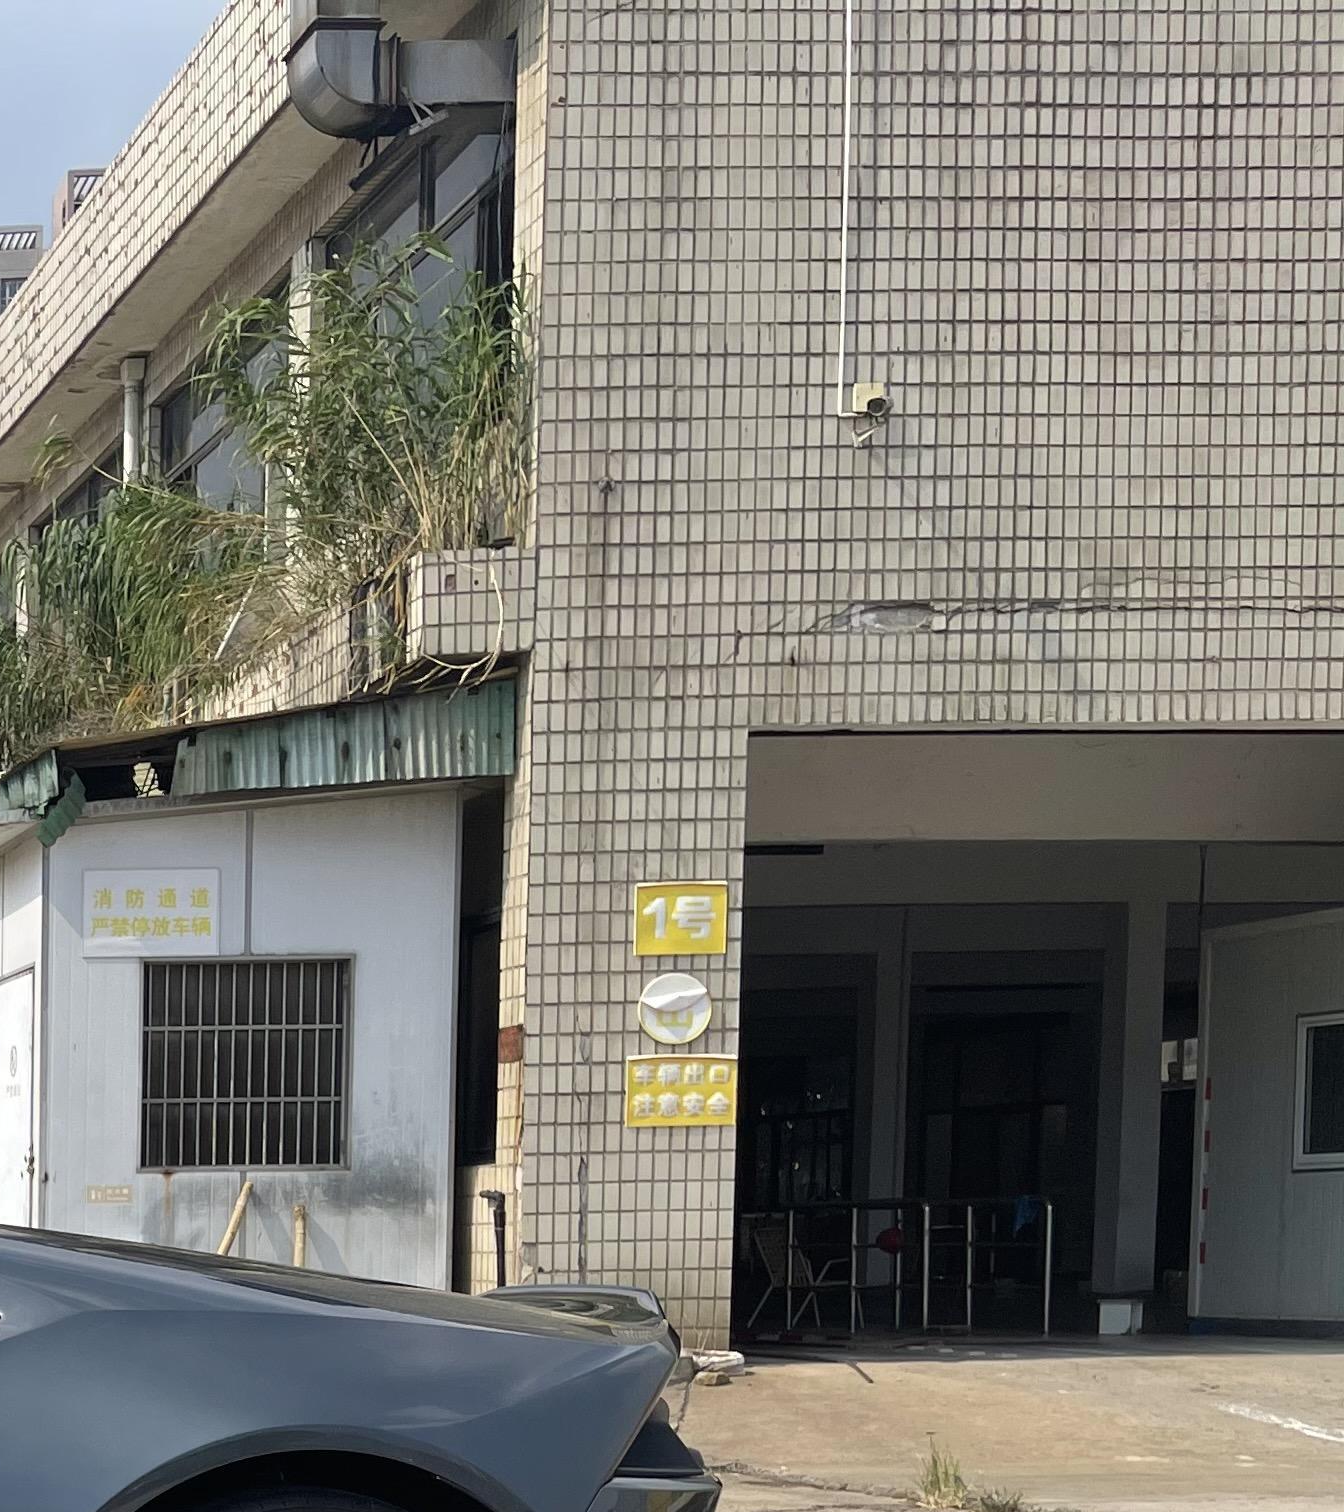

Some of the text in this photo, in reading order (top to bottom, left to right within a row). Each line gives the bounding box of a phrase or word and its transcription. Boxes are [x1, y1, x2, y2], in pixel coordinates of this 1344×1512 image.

[92, 887, 209, 909] 消防通道
[90, 916, 212, 937] 严禁停放车辆
[642, 895, 717, 940] 1号
[632, 1062, 730, 1087] 车辆出口
[632, 1091, 730, 1117] 注意安全
